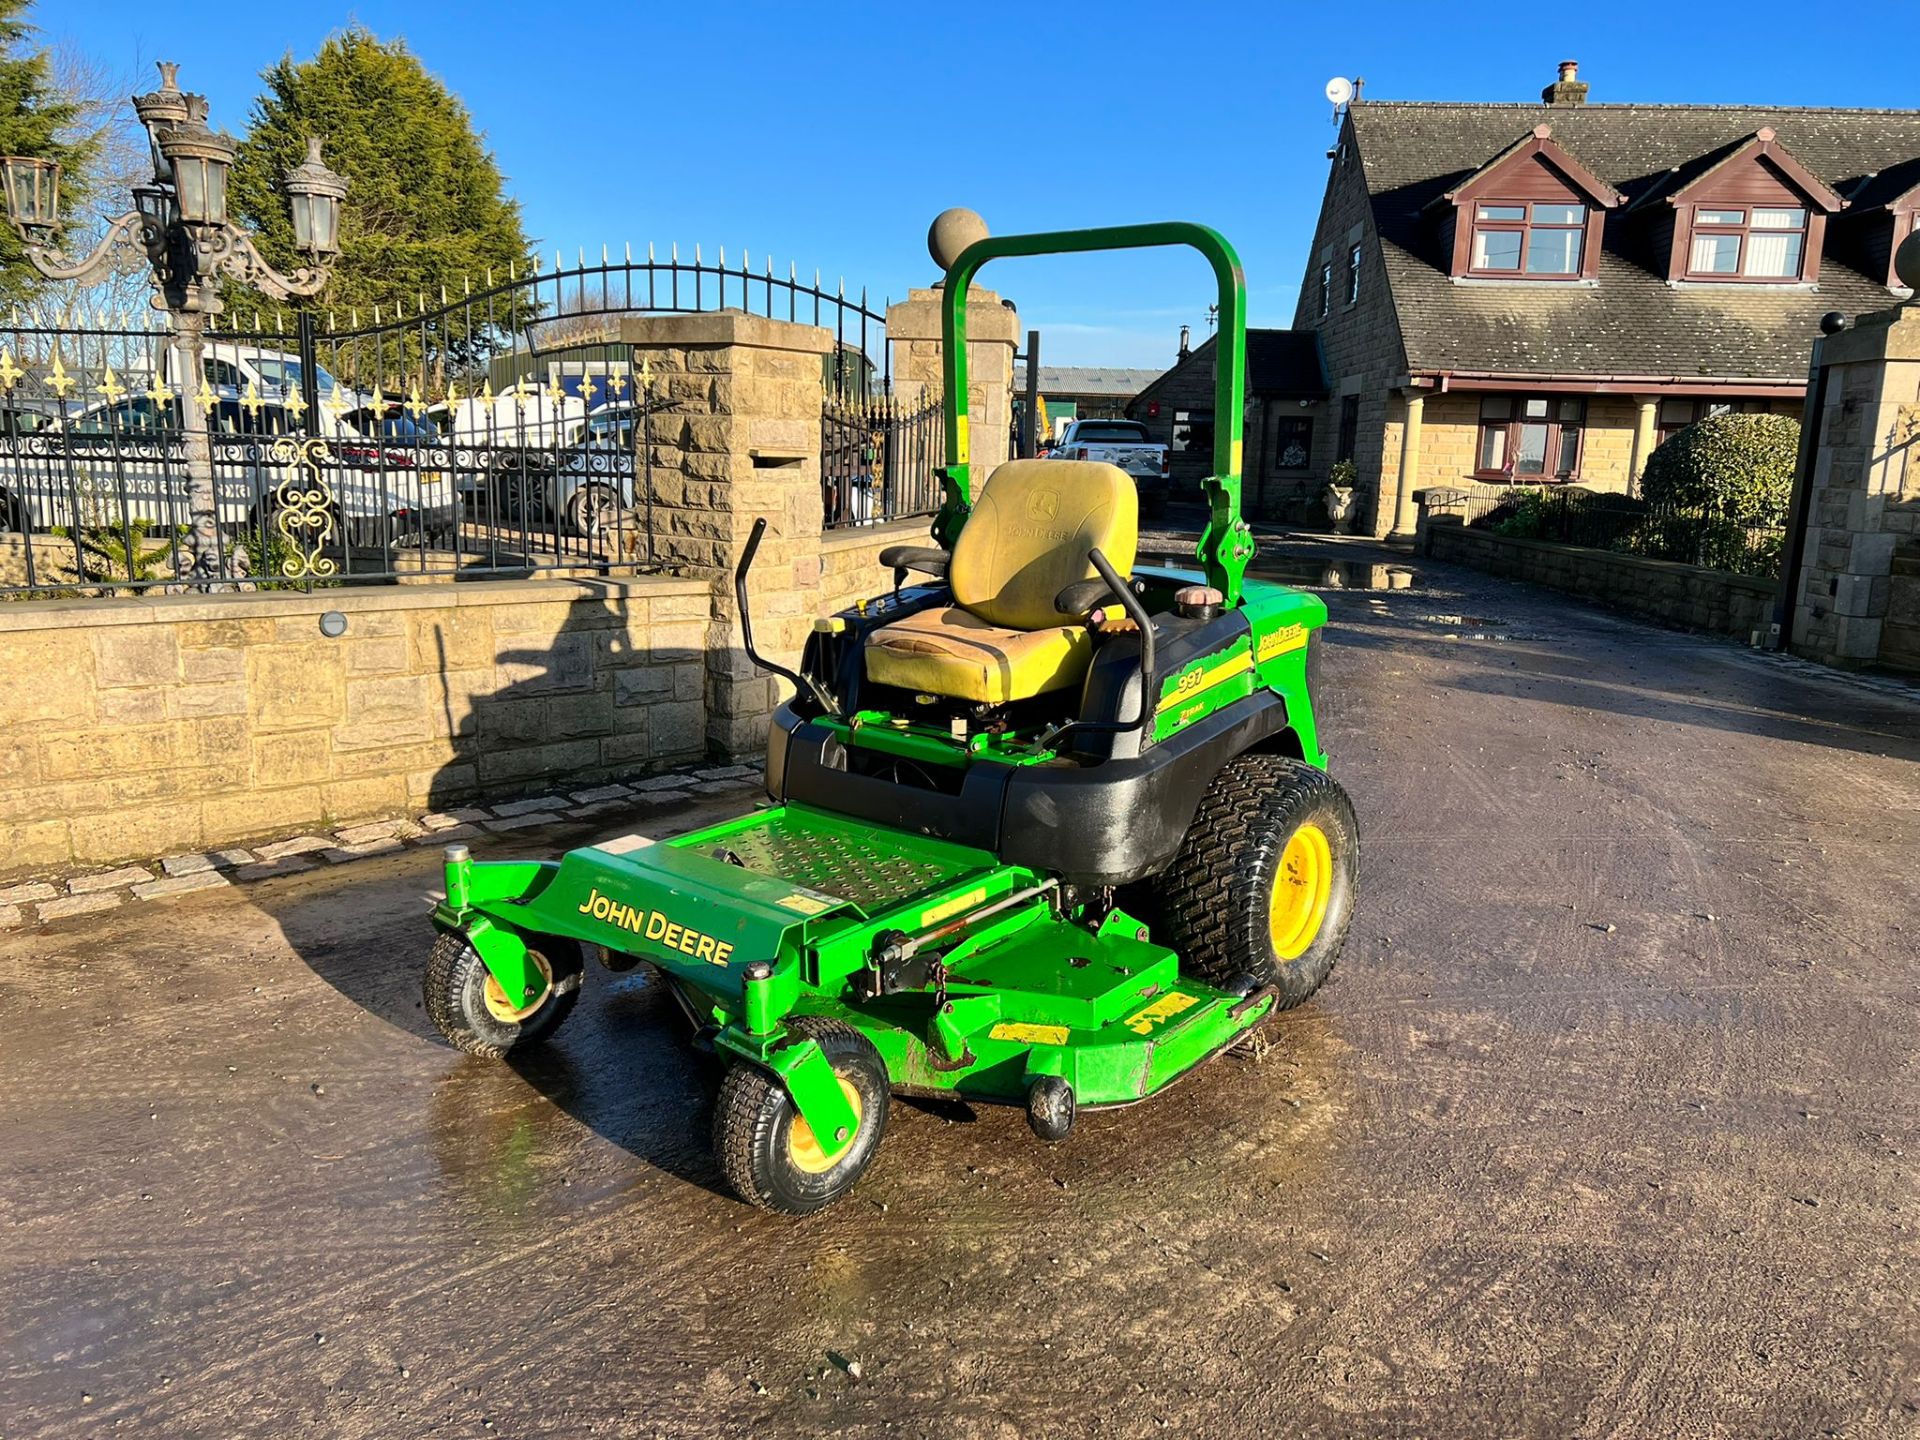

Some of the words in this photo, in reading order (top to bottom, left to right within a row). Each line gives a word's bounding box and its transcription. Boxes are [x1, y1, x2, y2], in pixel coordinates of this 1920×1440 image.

[1258, 632, 1280, 652] JOHN
[1279, 622, 1302, 643] DEERE
[1178, 667, 1203, 692] 997
[579, 887, 644, 933] JOHN
[645, 910, 734, 968] DEERE
